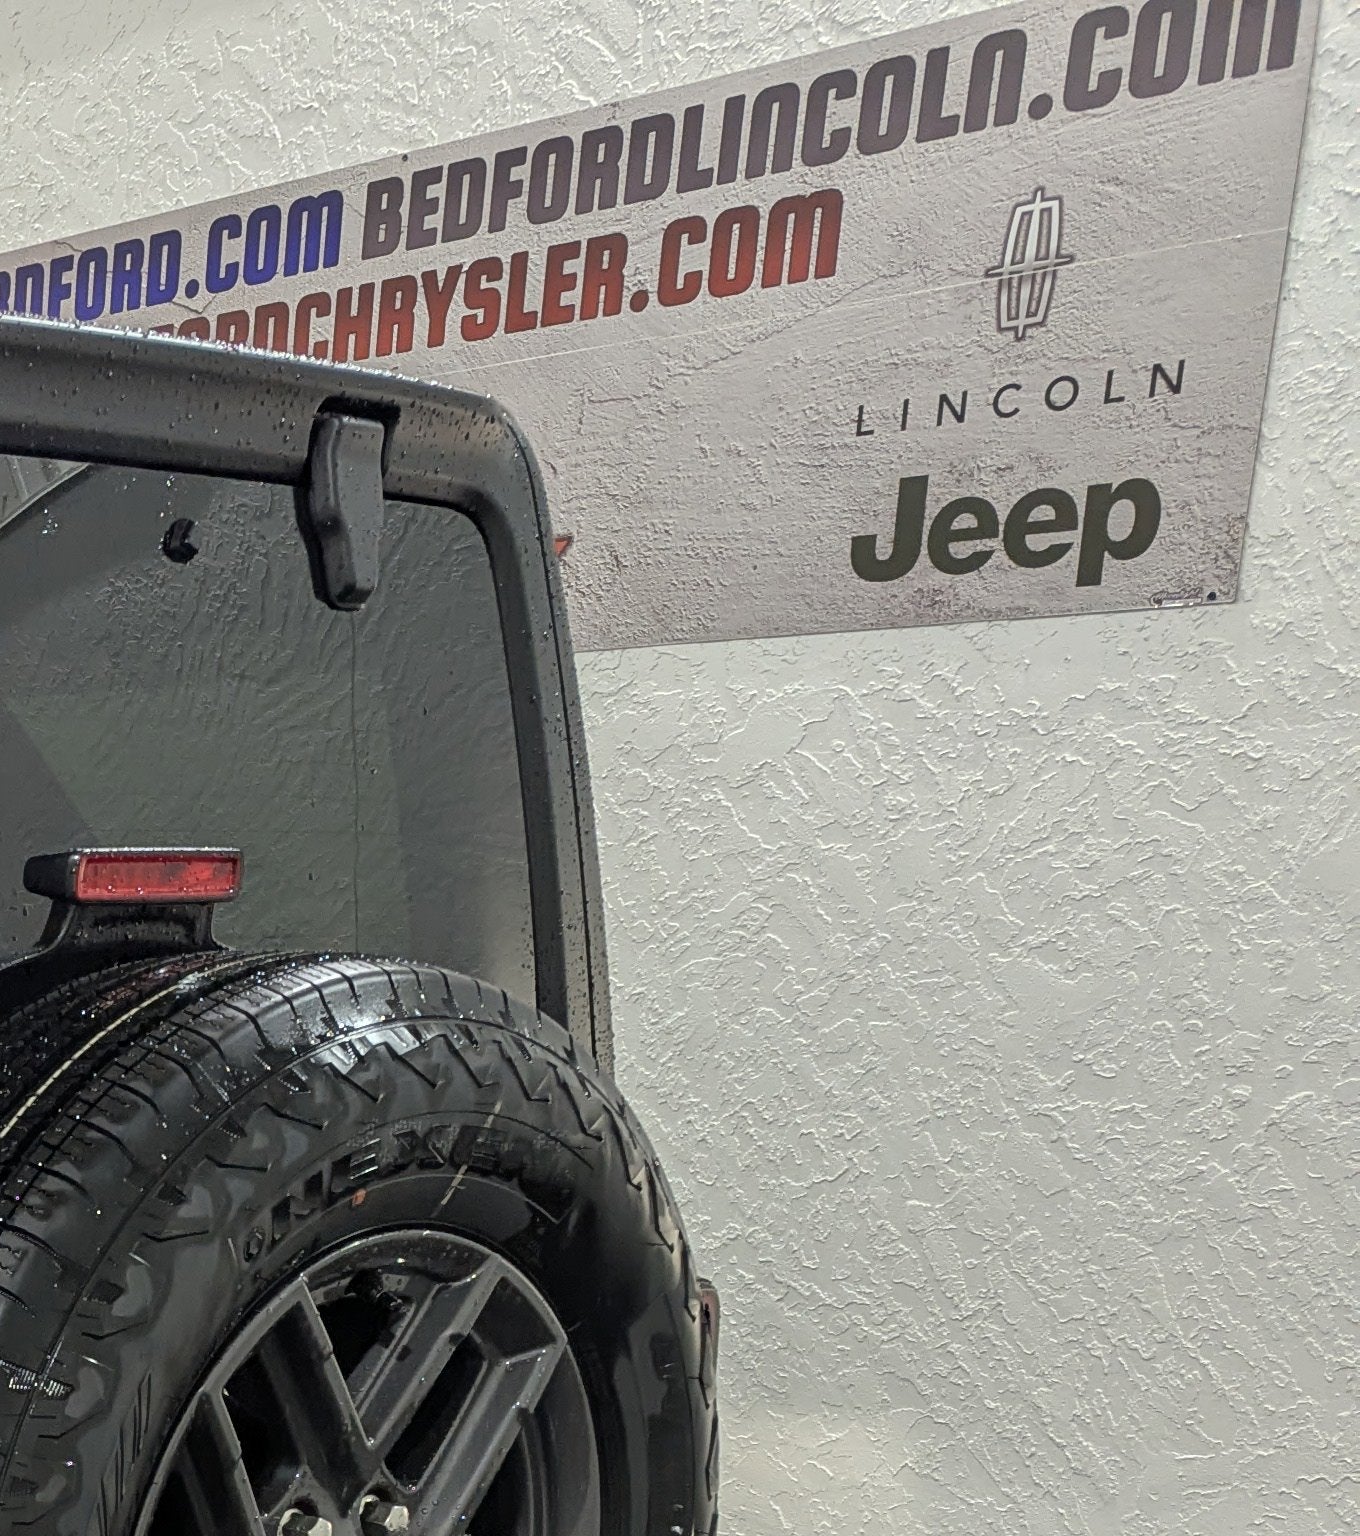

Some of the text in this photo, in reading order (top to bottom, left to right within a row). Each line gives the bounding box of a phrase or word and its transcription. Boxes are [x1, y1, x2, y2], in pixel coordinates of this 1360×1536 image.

[361, 0, 1301, 260] BEDFORDLINCOLN.COM
[855, 359, 1186, 437] LINCOLN
[850, 474, 1162, 588] Jeep
